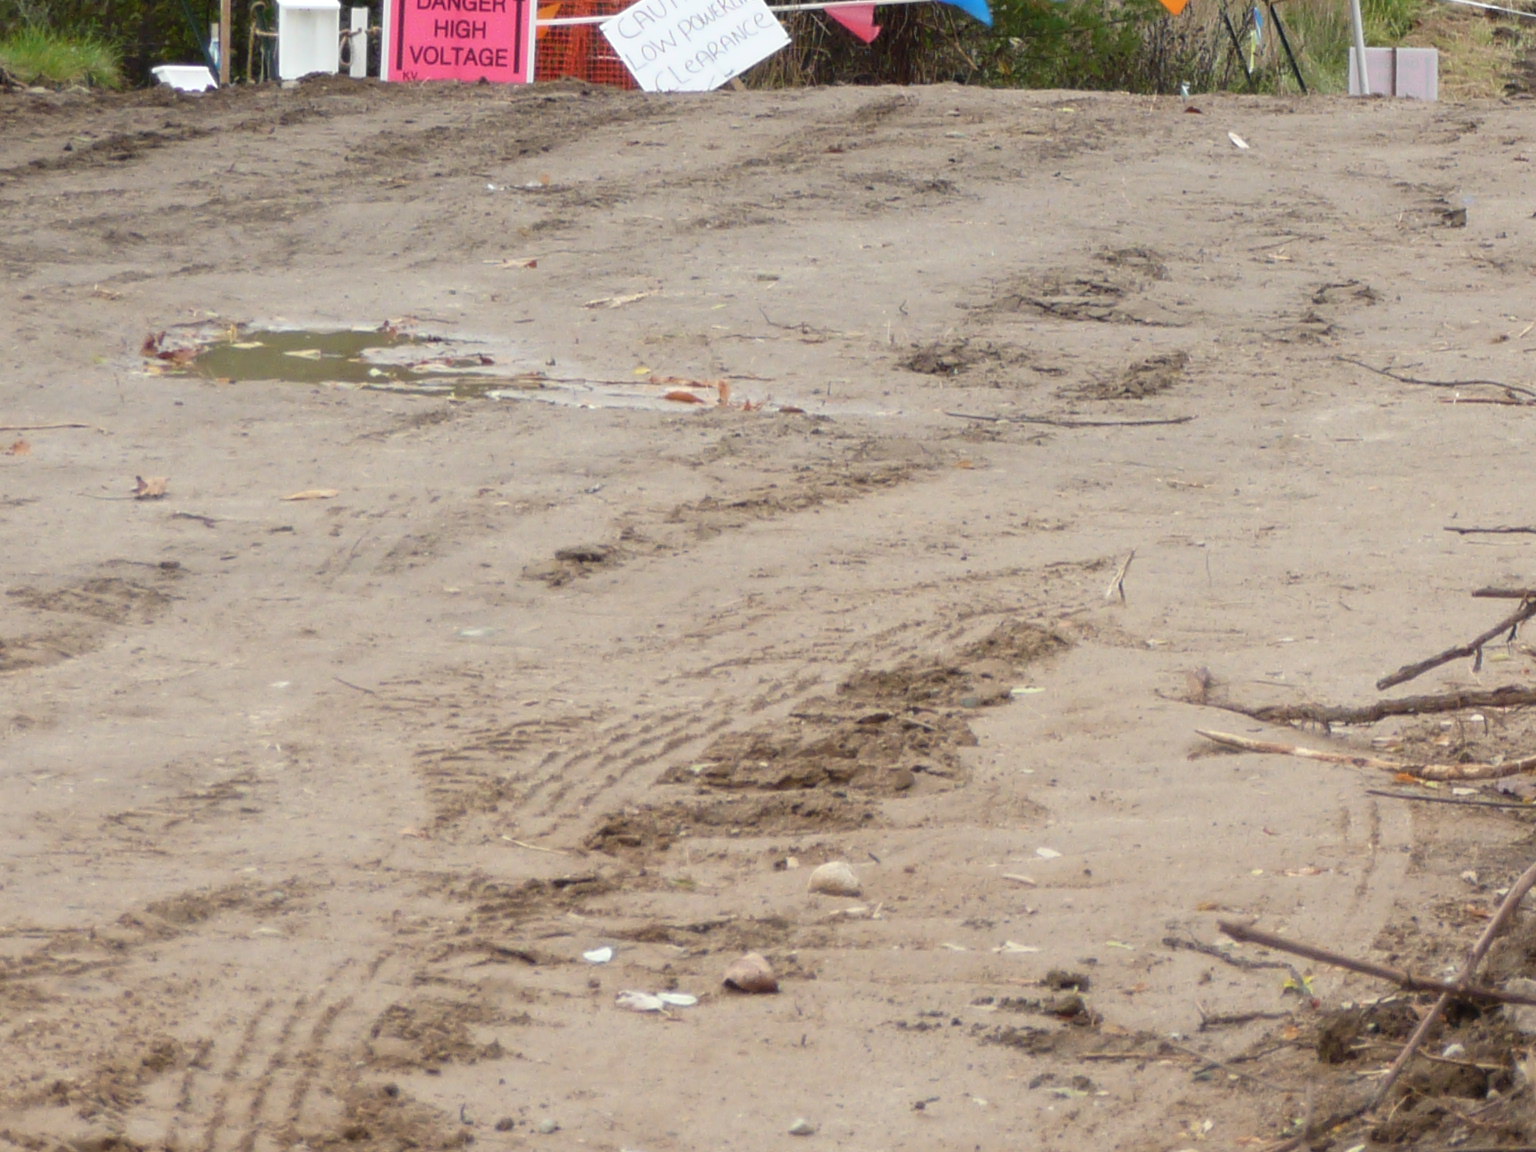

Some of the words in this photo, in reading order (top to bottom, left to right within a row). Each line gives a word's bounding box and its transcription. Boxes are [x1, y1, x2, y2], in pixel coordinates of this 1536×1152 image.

[433, 19, 487, 39] HIGH
[409, 46, 508, 67] VOLTAGE
[625, 29, 677, 72] LOW
